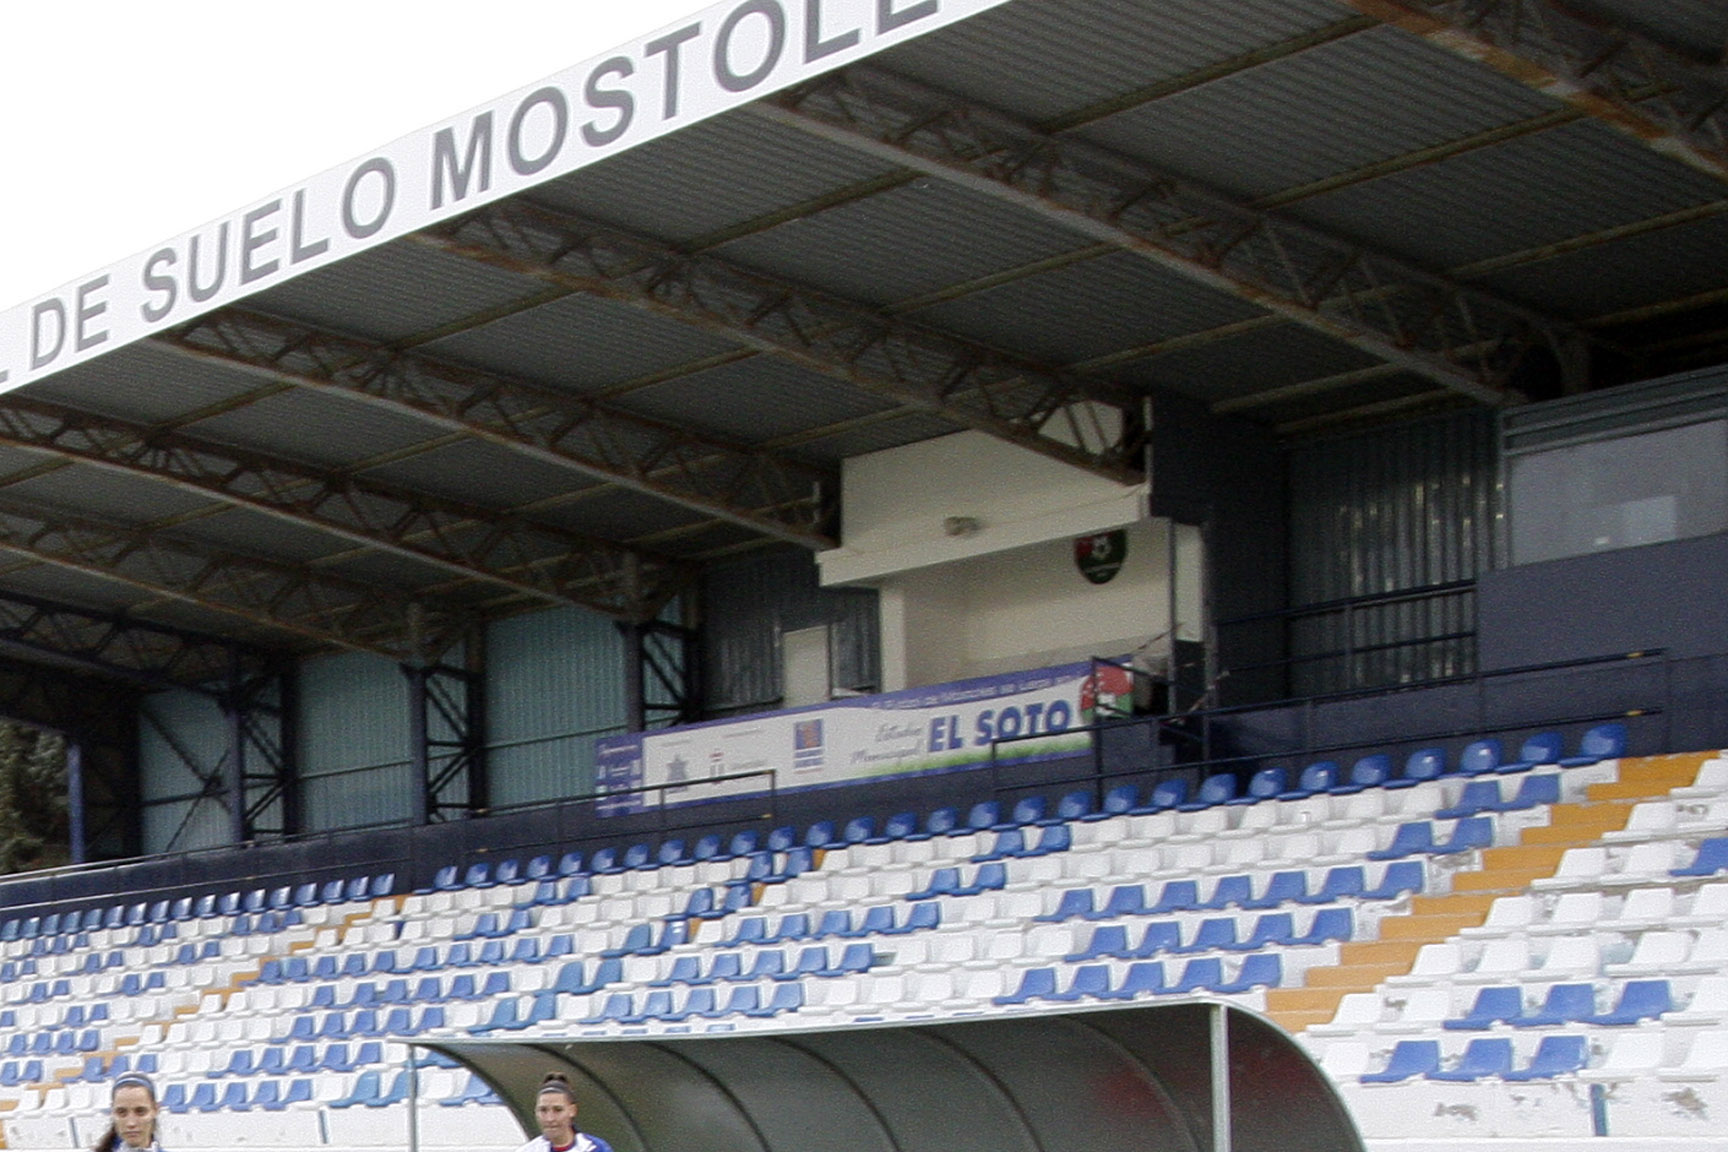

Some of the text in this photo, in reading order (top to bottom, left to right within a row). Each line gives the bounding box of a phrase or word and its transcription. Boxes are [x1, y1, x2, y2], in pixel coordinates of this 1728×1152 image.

[29, 273, 111, 372] DE
[140, 157, 397, 323] SUELO
[927, 699, 1071, 752] EL SOTO
